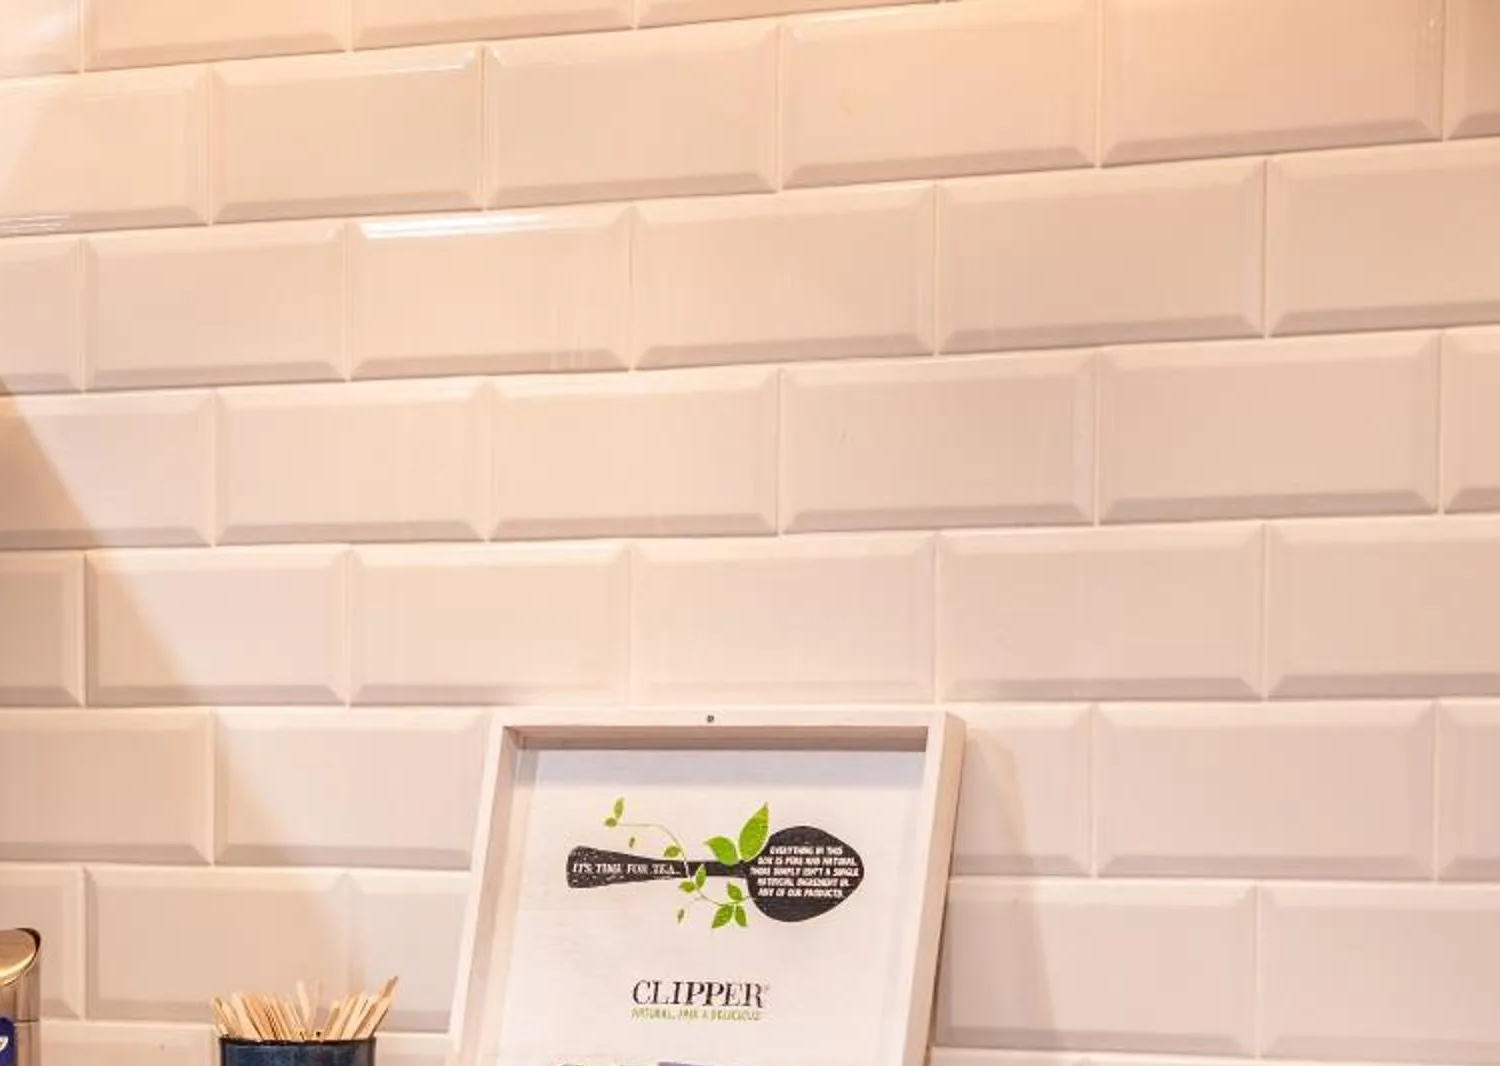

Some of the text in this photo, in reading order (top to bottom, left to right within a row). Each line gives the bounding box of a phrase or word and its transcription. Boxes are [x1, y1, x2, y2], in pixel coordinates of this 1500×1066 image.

[769, 845, 843, 855] EVERYTHING IN THIS
[774, 856, 783, 865] IS
[785, 856, 803, 866] PURE
[805, 857, 821, 866] AND
[596, 863, 621, 874] TIME
[627, 863, 649, 874] FOR
[773, 867, 801, 876] SIMPLY
[824, 868, 831, 876] A
[832, 867, 859, 877] SINGLE
[757, 877, 794, 887] ARTIFICIAL
[795, 878, 838, 887] INGREDIENT
[757, 887, 774, 897] ANY
[775, 888, 786, 897] OF
[787, 888, 803, 897] OUR
[632, 979, 763, 1009] CLIPPER
